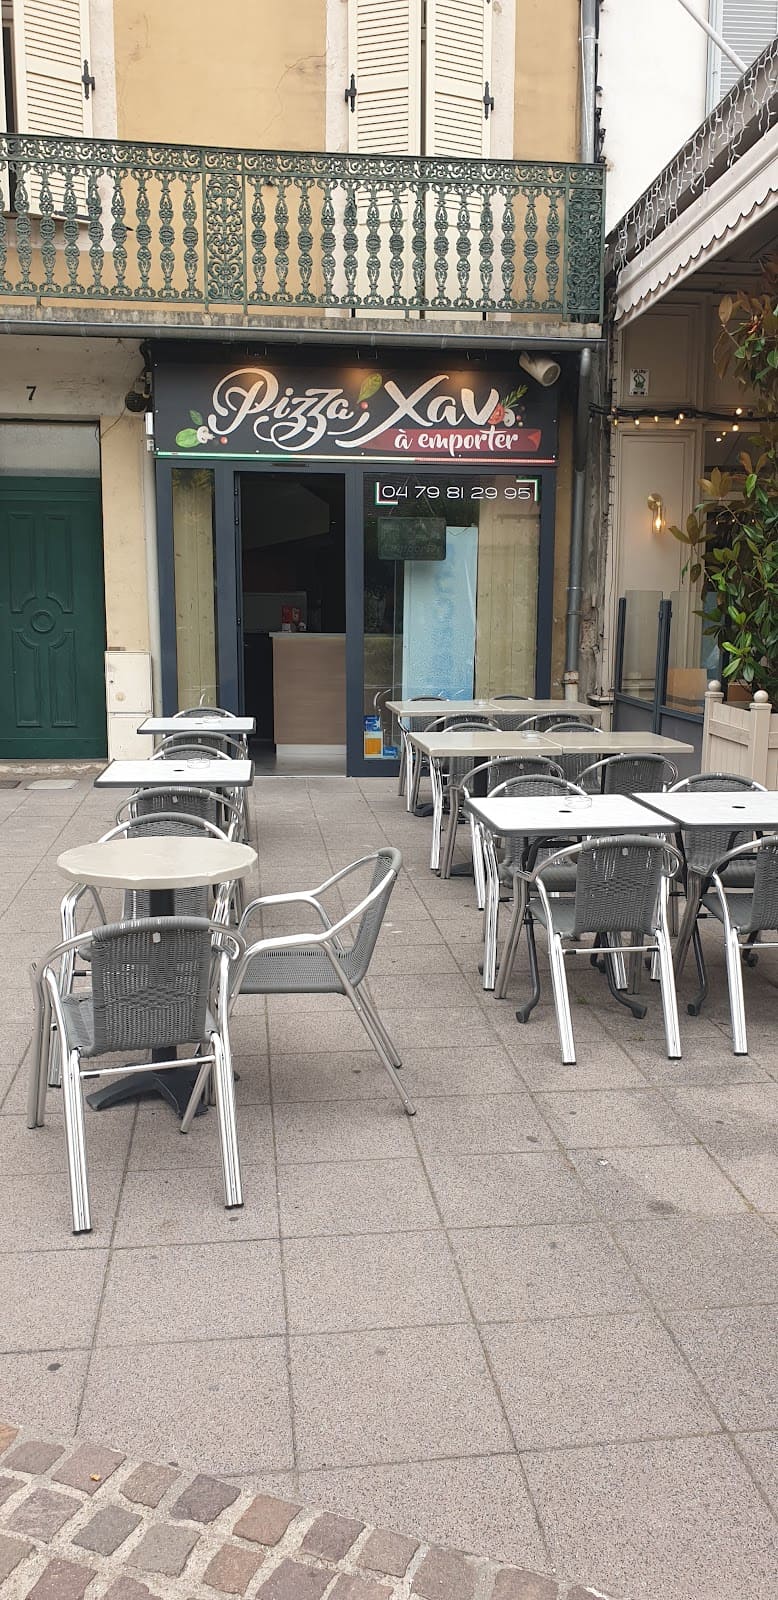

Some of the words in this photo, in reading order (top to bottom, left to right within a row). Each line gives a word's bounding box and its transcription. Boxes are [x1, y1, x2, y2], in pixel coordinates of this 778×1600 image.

[26, 386, 37, 401] 7
[208, 368, 354, 451] Pizza
[394, 429, 413, 449] à
[416, 426, 520, 456] emporter
[381, 485, 408, 499] 04
[414, 486, 440, 499] 79
[446, 486, 464, 499] 81
[471, 487, 498, 500] 29
[504, 487, 531, 500] 95
